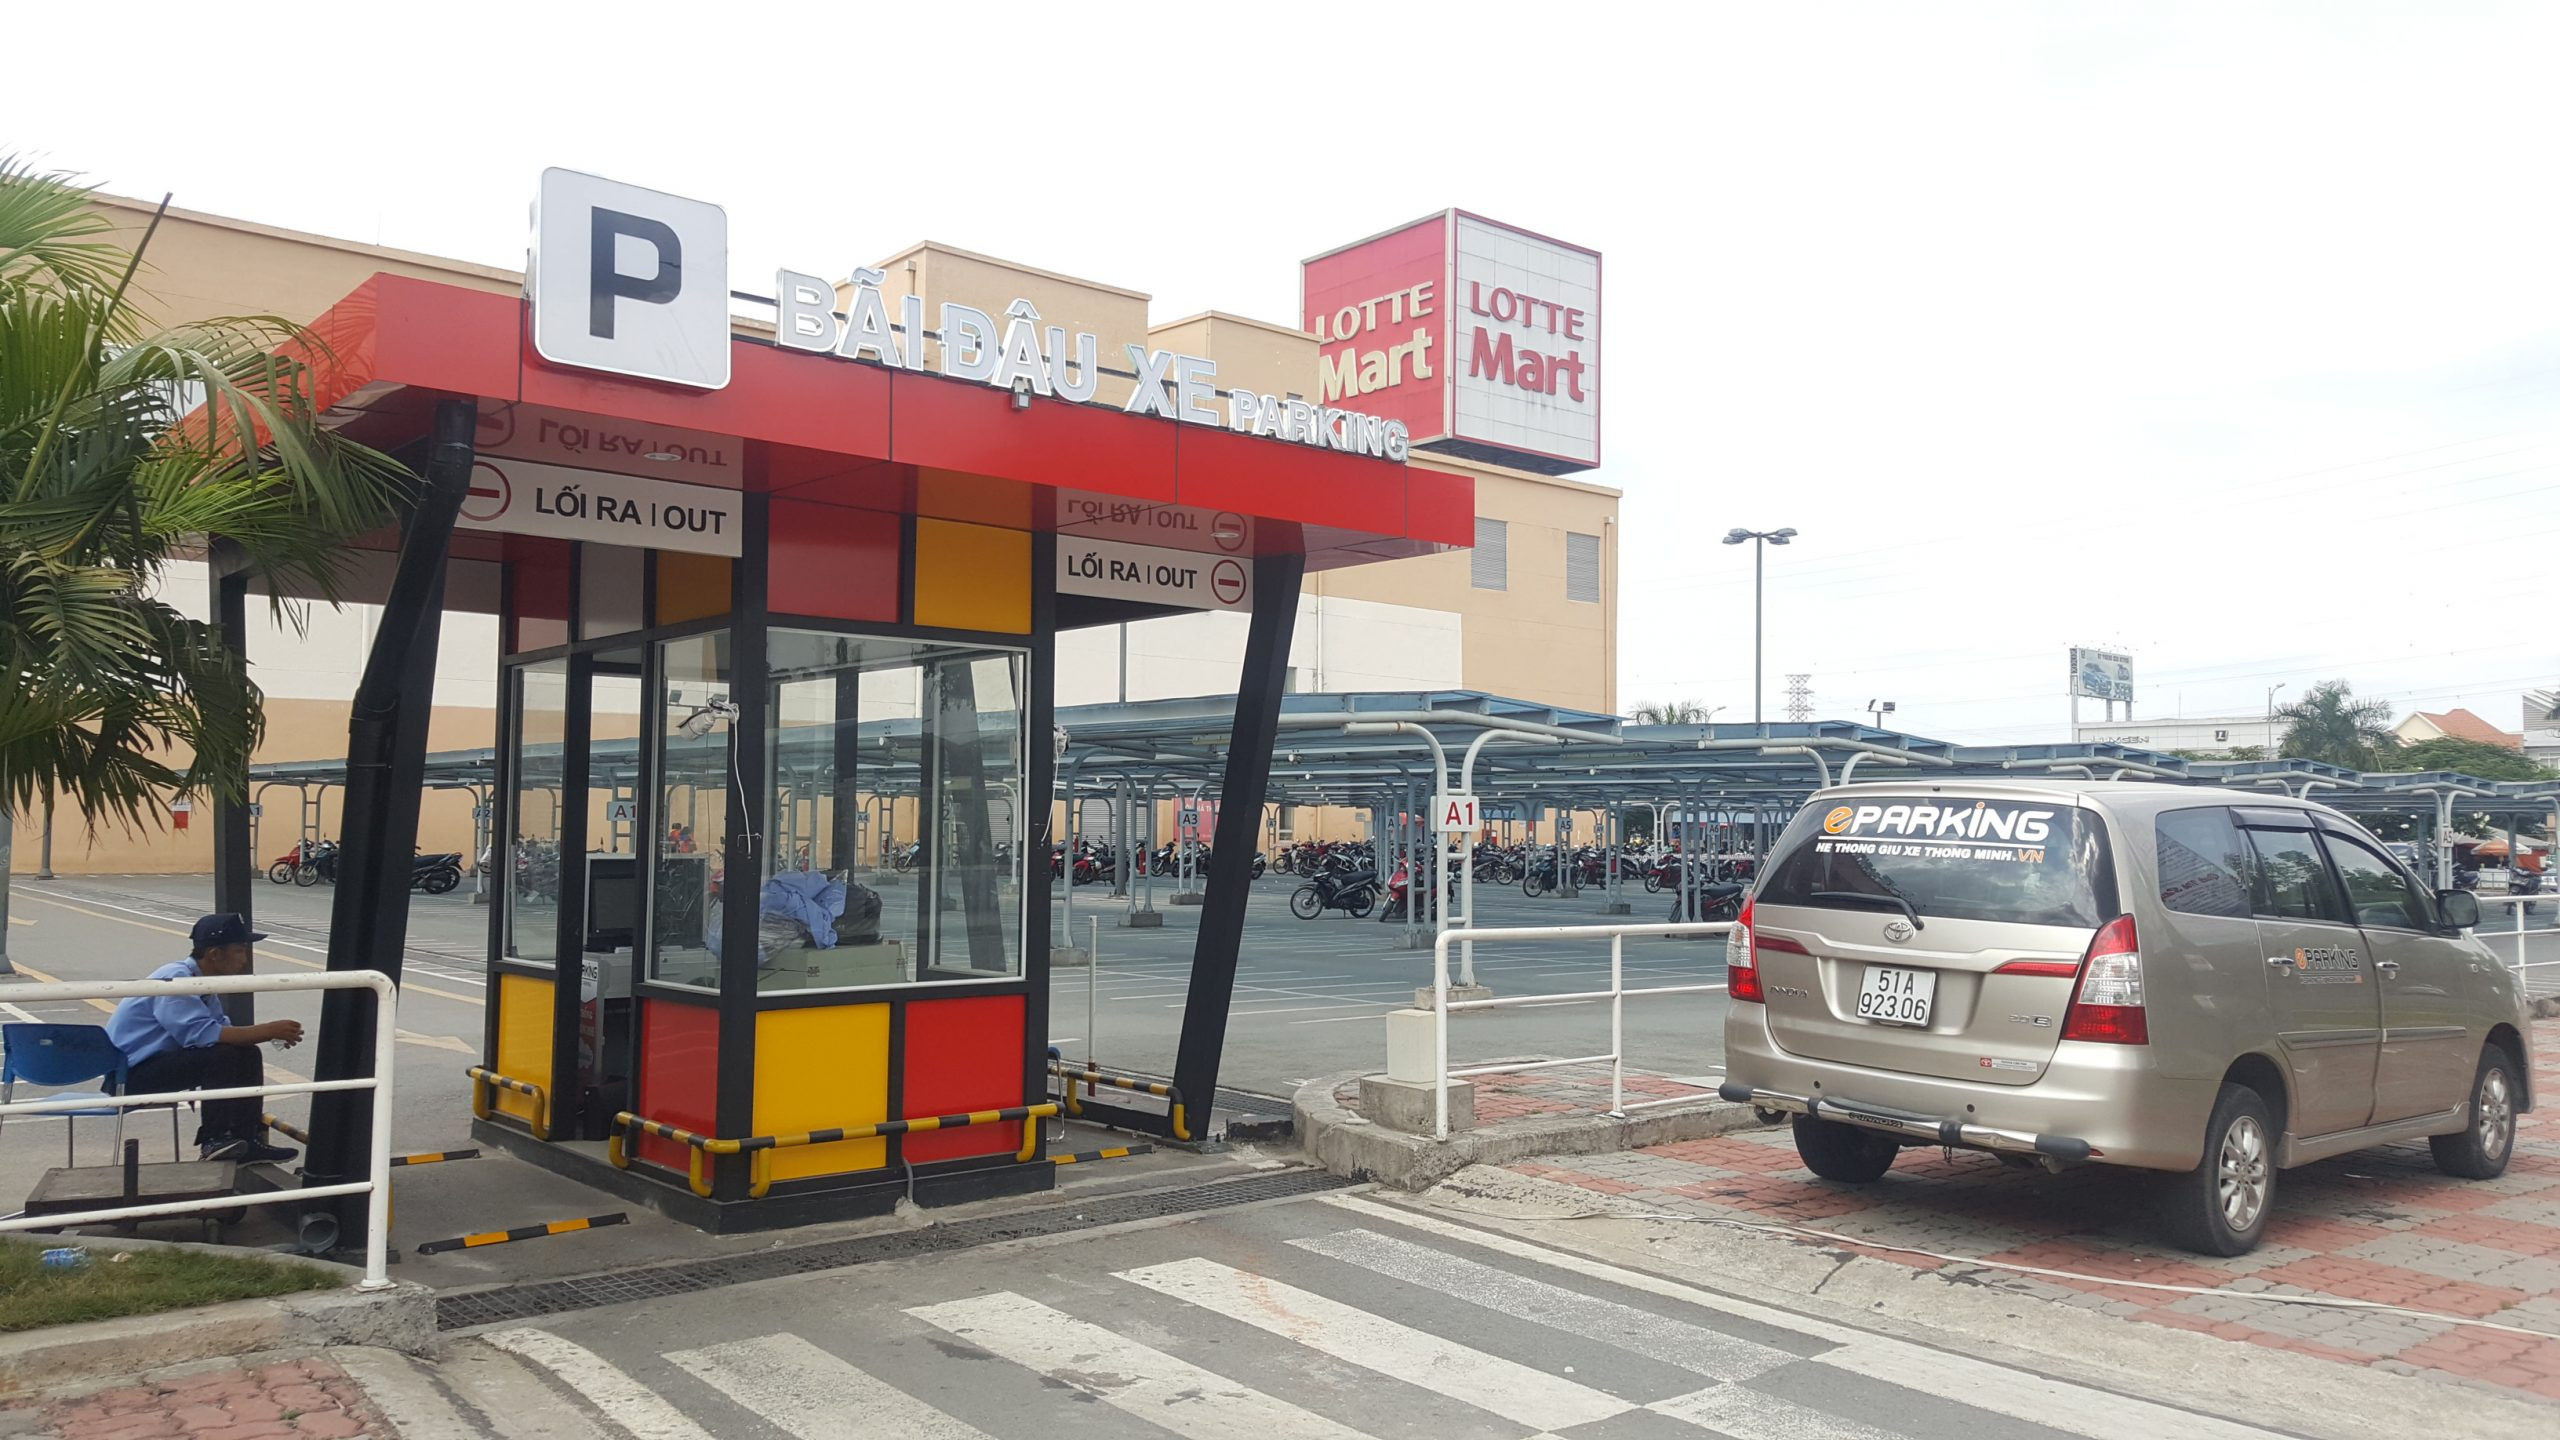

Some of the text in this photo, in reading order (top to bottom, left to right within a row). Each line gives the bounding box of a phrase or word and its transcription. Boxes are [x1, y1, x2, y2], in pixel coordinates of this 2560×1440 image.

[589, 206, 682, 340] P
[1313, 280, 1435, 346] LOTTE
[1470, 280, 1585, 342] LOTTE
[776, 267, 924, 372] BÃI
[1124, 343, 1219, 427] XE
[1228, 388, 1410, 463] PARKING
[1318, 327, 1434, 404] Mart
[1468, 325, 1586, 403] Mart
[535, 484, 727, 535] LỐI RA OUT
[1067, 552, 1198, 590] LỐI RA OUT
[614, 804, 636, 818] A1
[1182, 813, 1198, 825] A3
[1445, 801, 1473, 826] A1
[1835, 843, 1876, 854] THONG
[1878, 844, 1901, 855] GIU
[1902, 845, 1921, 856] XE
[1925, 846, 1972, 859] THONG
[1877, 970, 1914, 996] 51A
[1859, 992, 1927, 1021] 923.06
